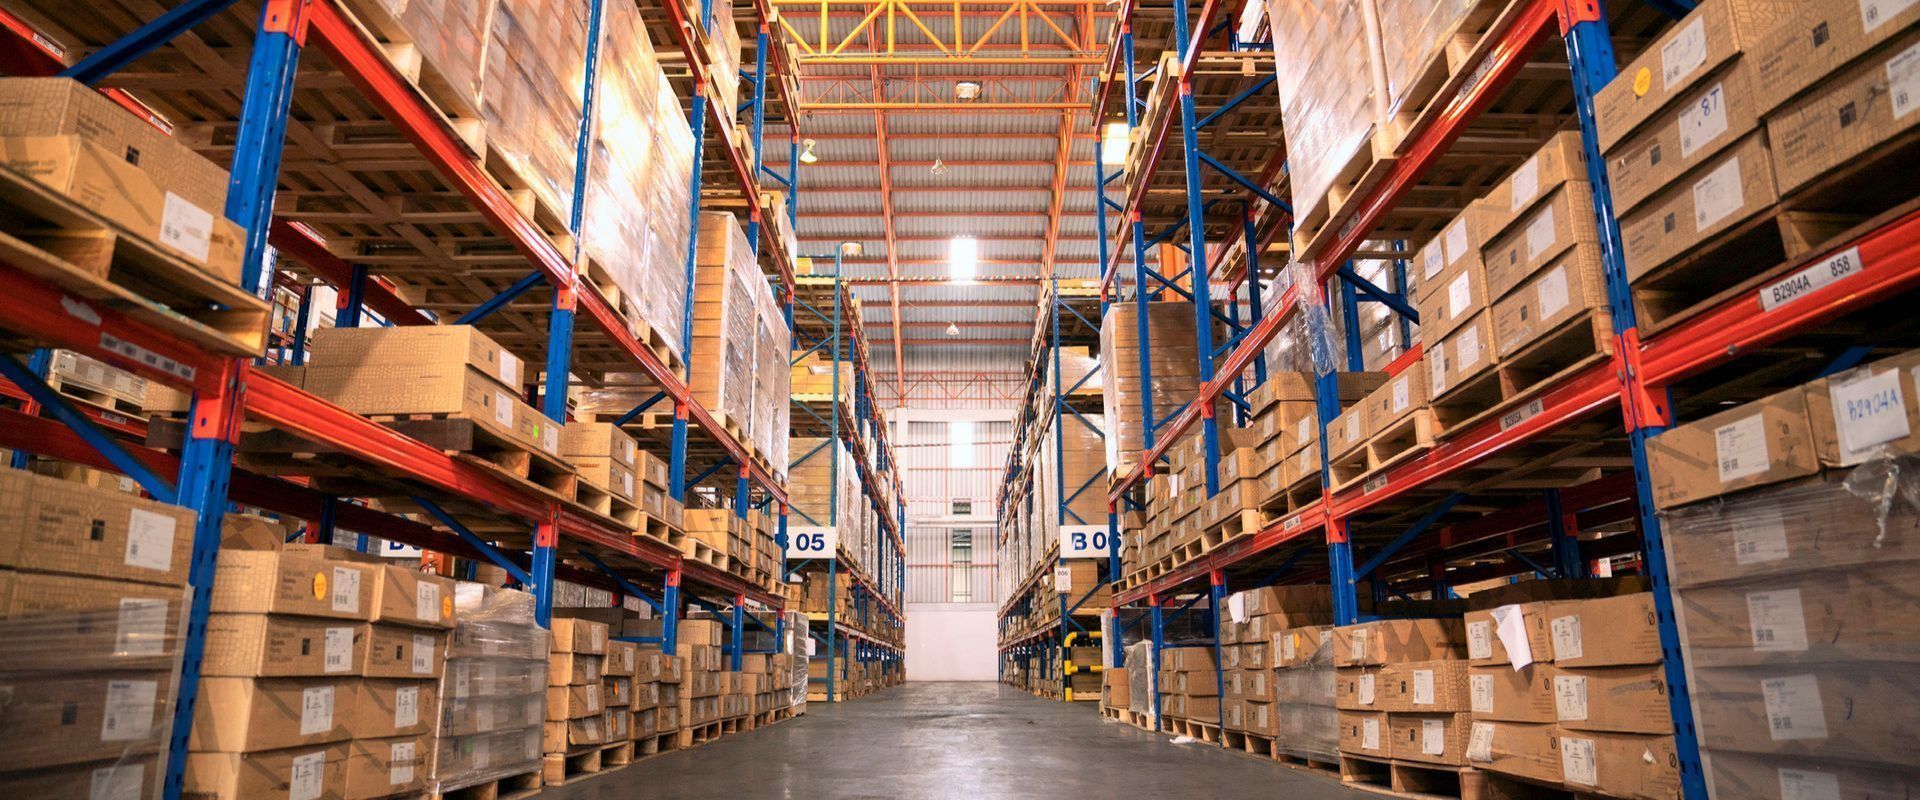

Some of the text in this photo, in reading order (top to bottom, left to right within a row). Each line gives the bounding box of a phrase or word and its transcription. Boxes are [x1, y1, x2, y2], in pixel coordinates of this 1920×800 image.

[1773, 255, 1850, 303] B2904A 858
[1847, 388, 1899, 421] B2904A
[795, 533, 825, 551] 05
[1071, 532, 1088, 550] B
